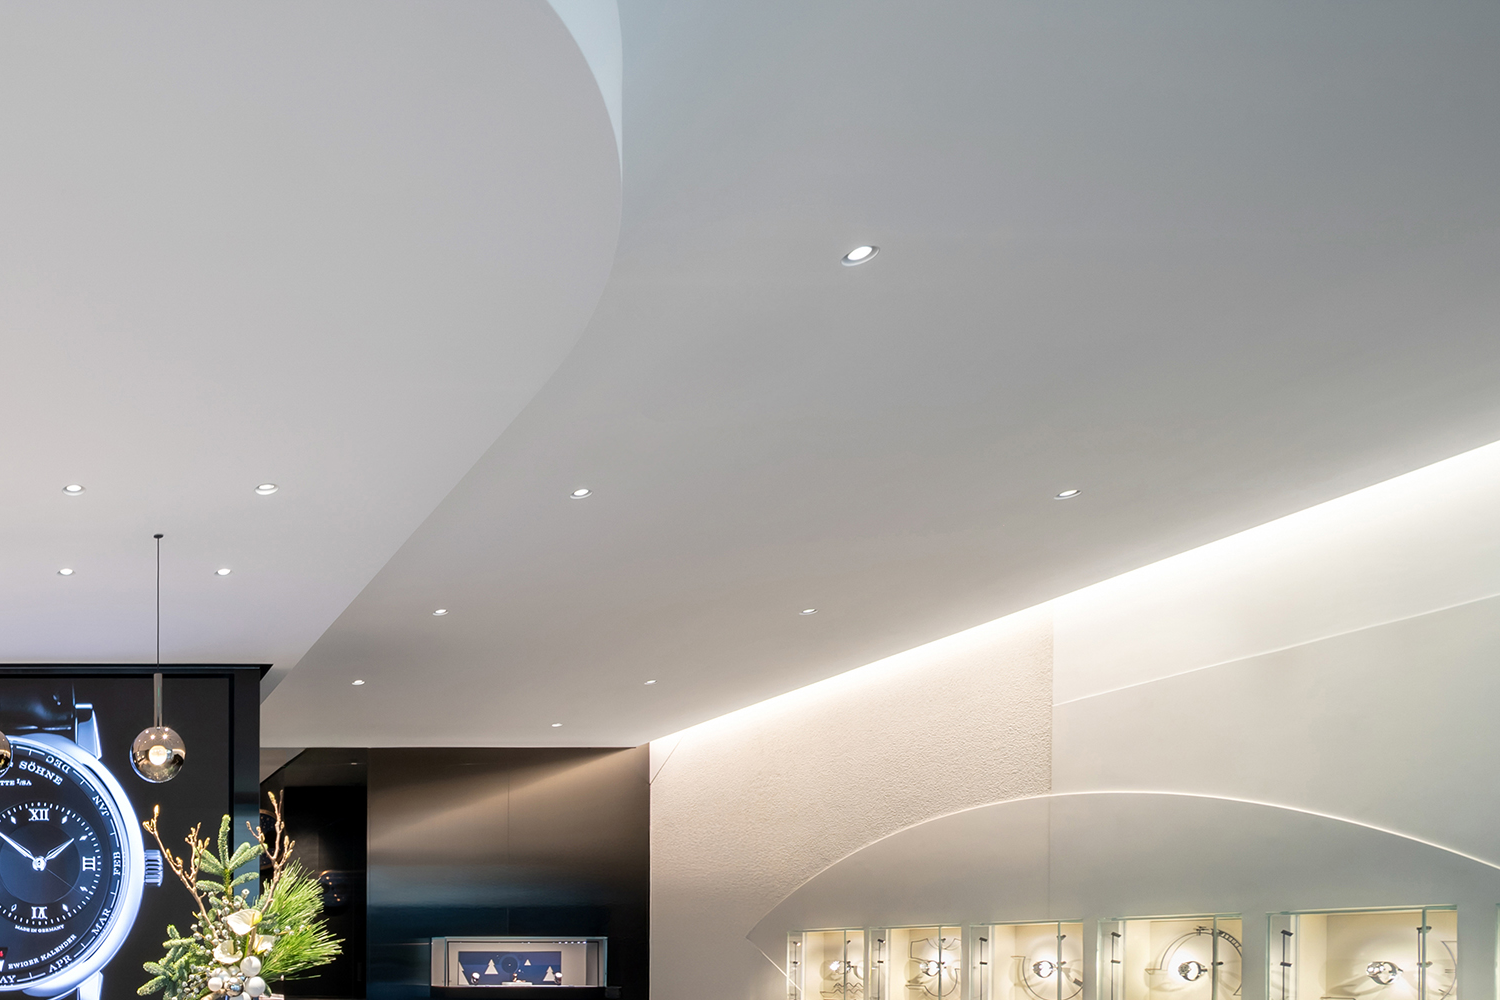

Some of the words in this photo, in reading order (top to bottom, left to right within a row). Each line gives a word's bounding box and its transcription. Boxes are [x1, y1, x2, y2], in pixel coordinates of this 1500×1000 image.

[19, 760, 64, 786] SÖHNE
[45, 755, 71, 774] DEC
[28, 808, 50, 821] XII
[92, 795, 110, 817] JAN
[82, 856, 96, 872] III
[113, 851, 121, 876] FEB
[38, 924, 65, 933] GERMANY
[91, 908, 112, 936] MAR
[8, 957, 40, 970] EWIGER
[40, 933, 77, 961] KALENDER
[49, 954, 73, 973] APR
